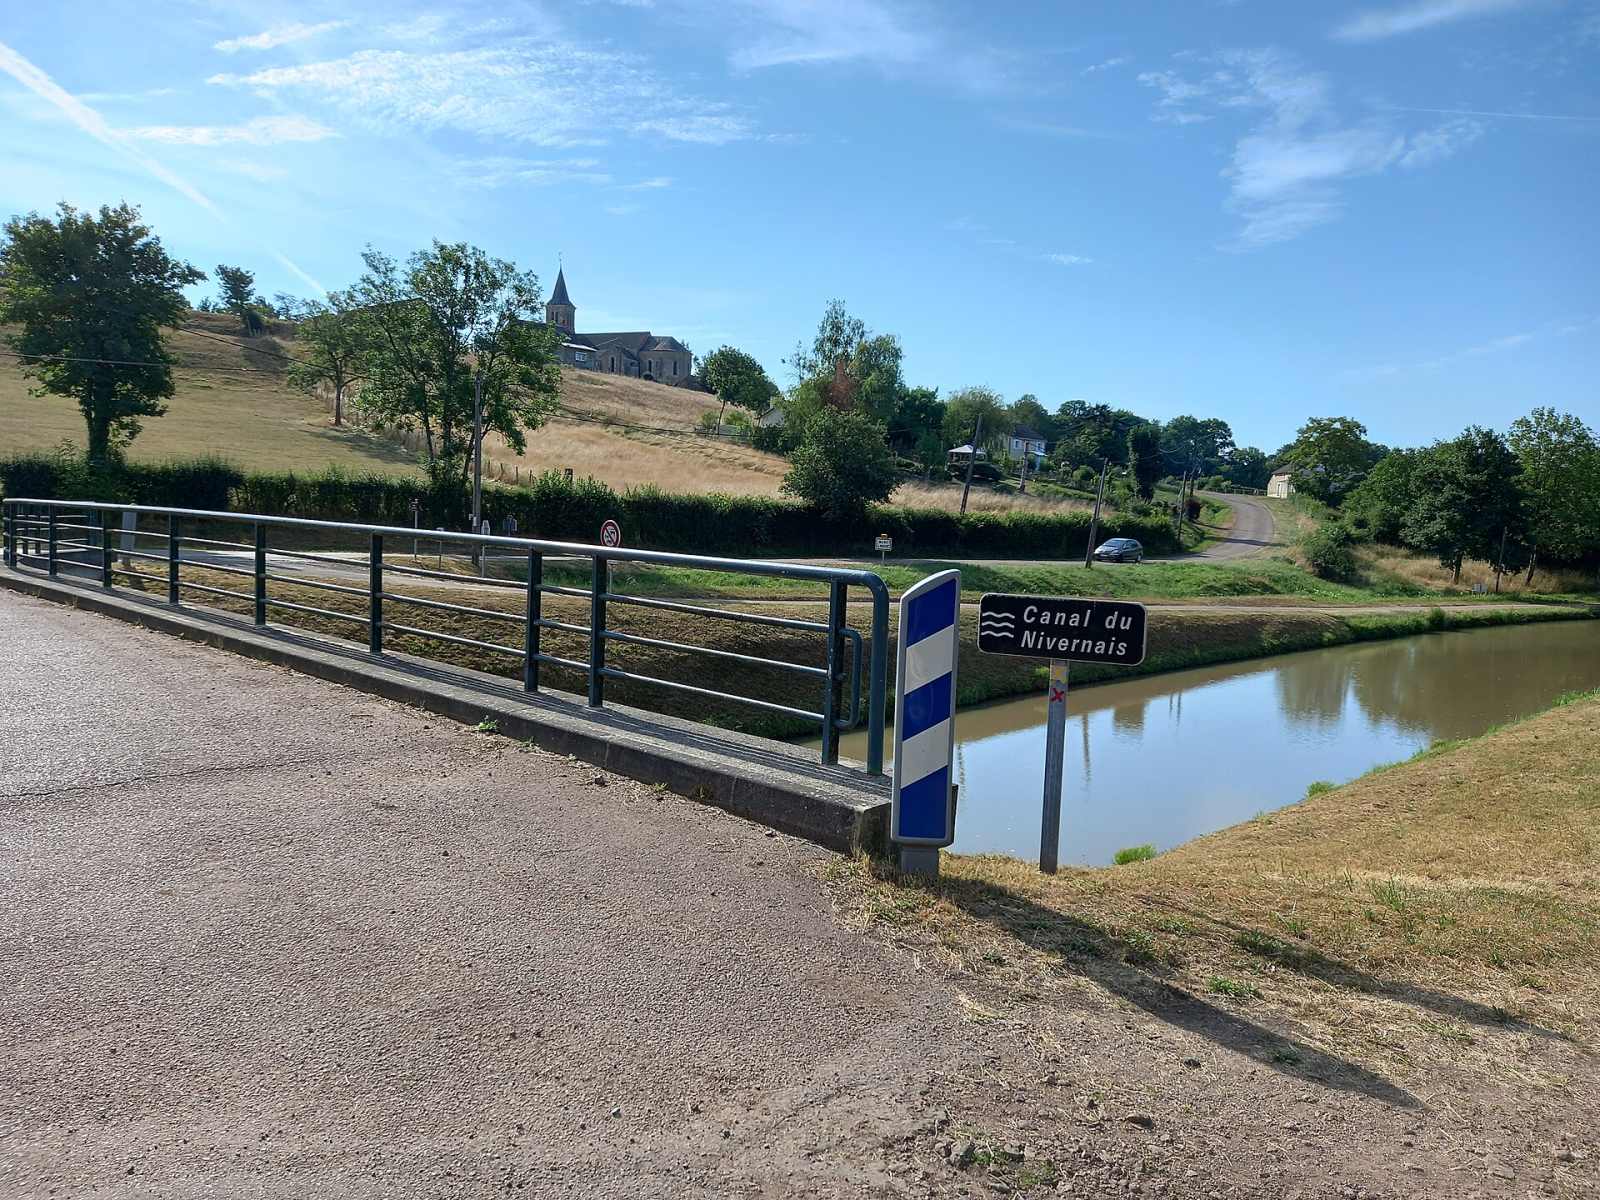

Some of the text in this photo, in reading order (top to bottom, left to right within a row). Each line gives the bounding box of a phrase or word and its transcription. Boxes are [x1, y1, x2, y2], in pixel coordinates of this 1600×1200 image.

[1023, 605, 1133, 631] Canal du
[1020, 630, 1128, 656] Nivernais
